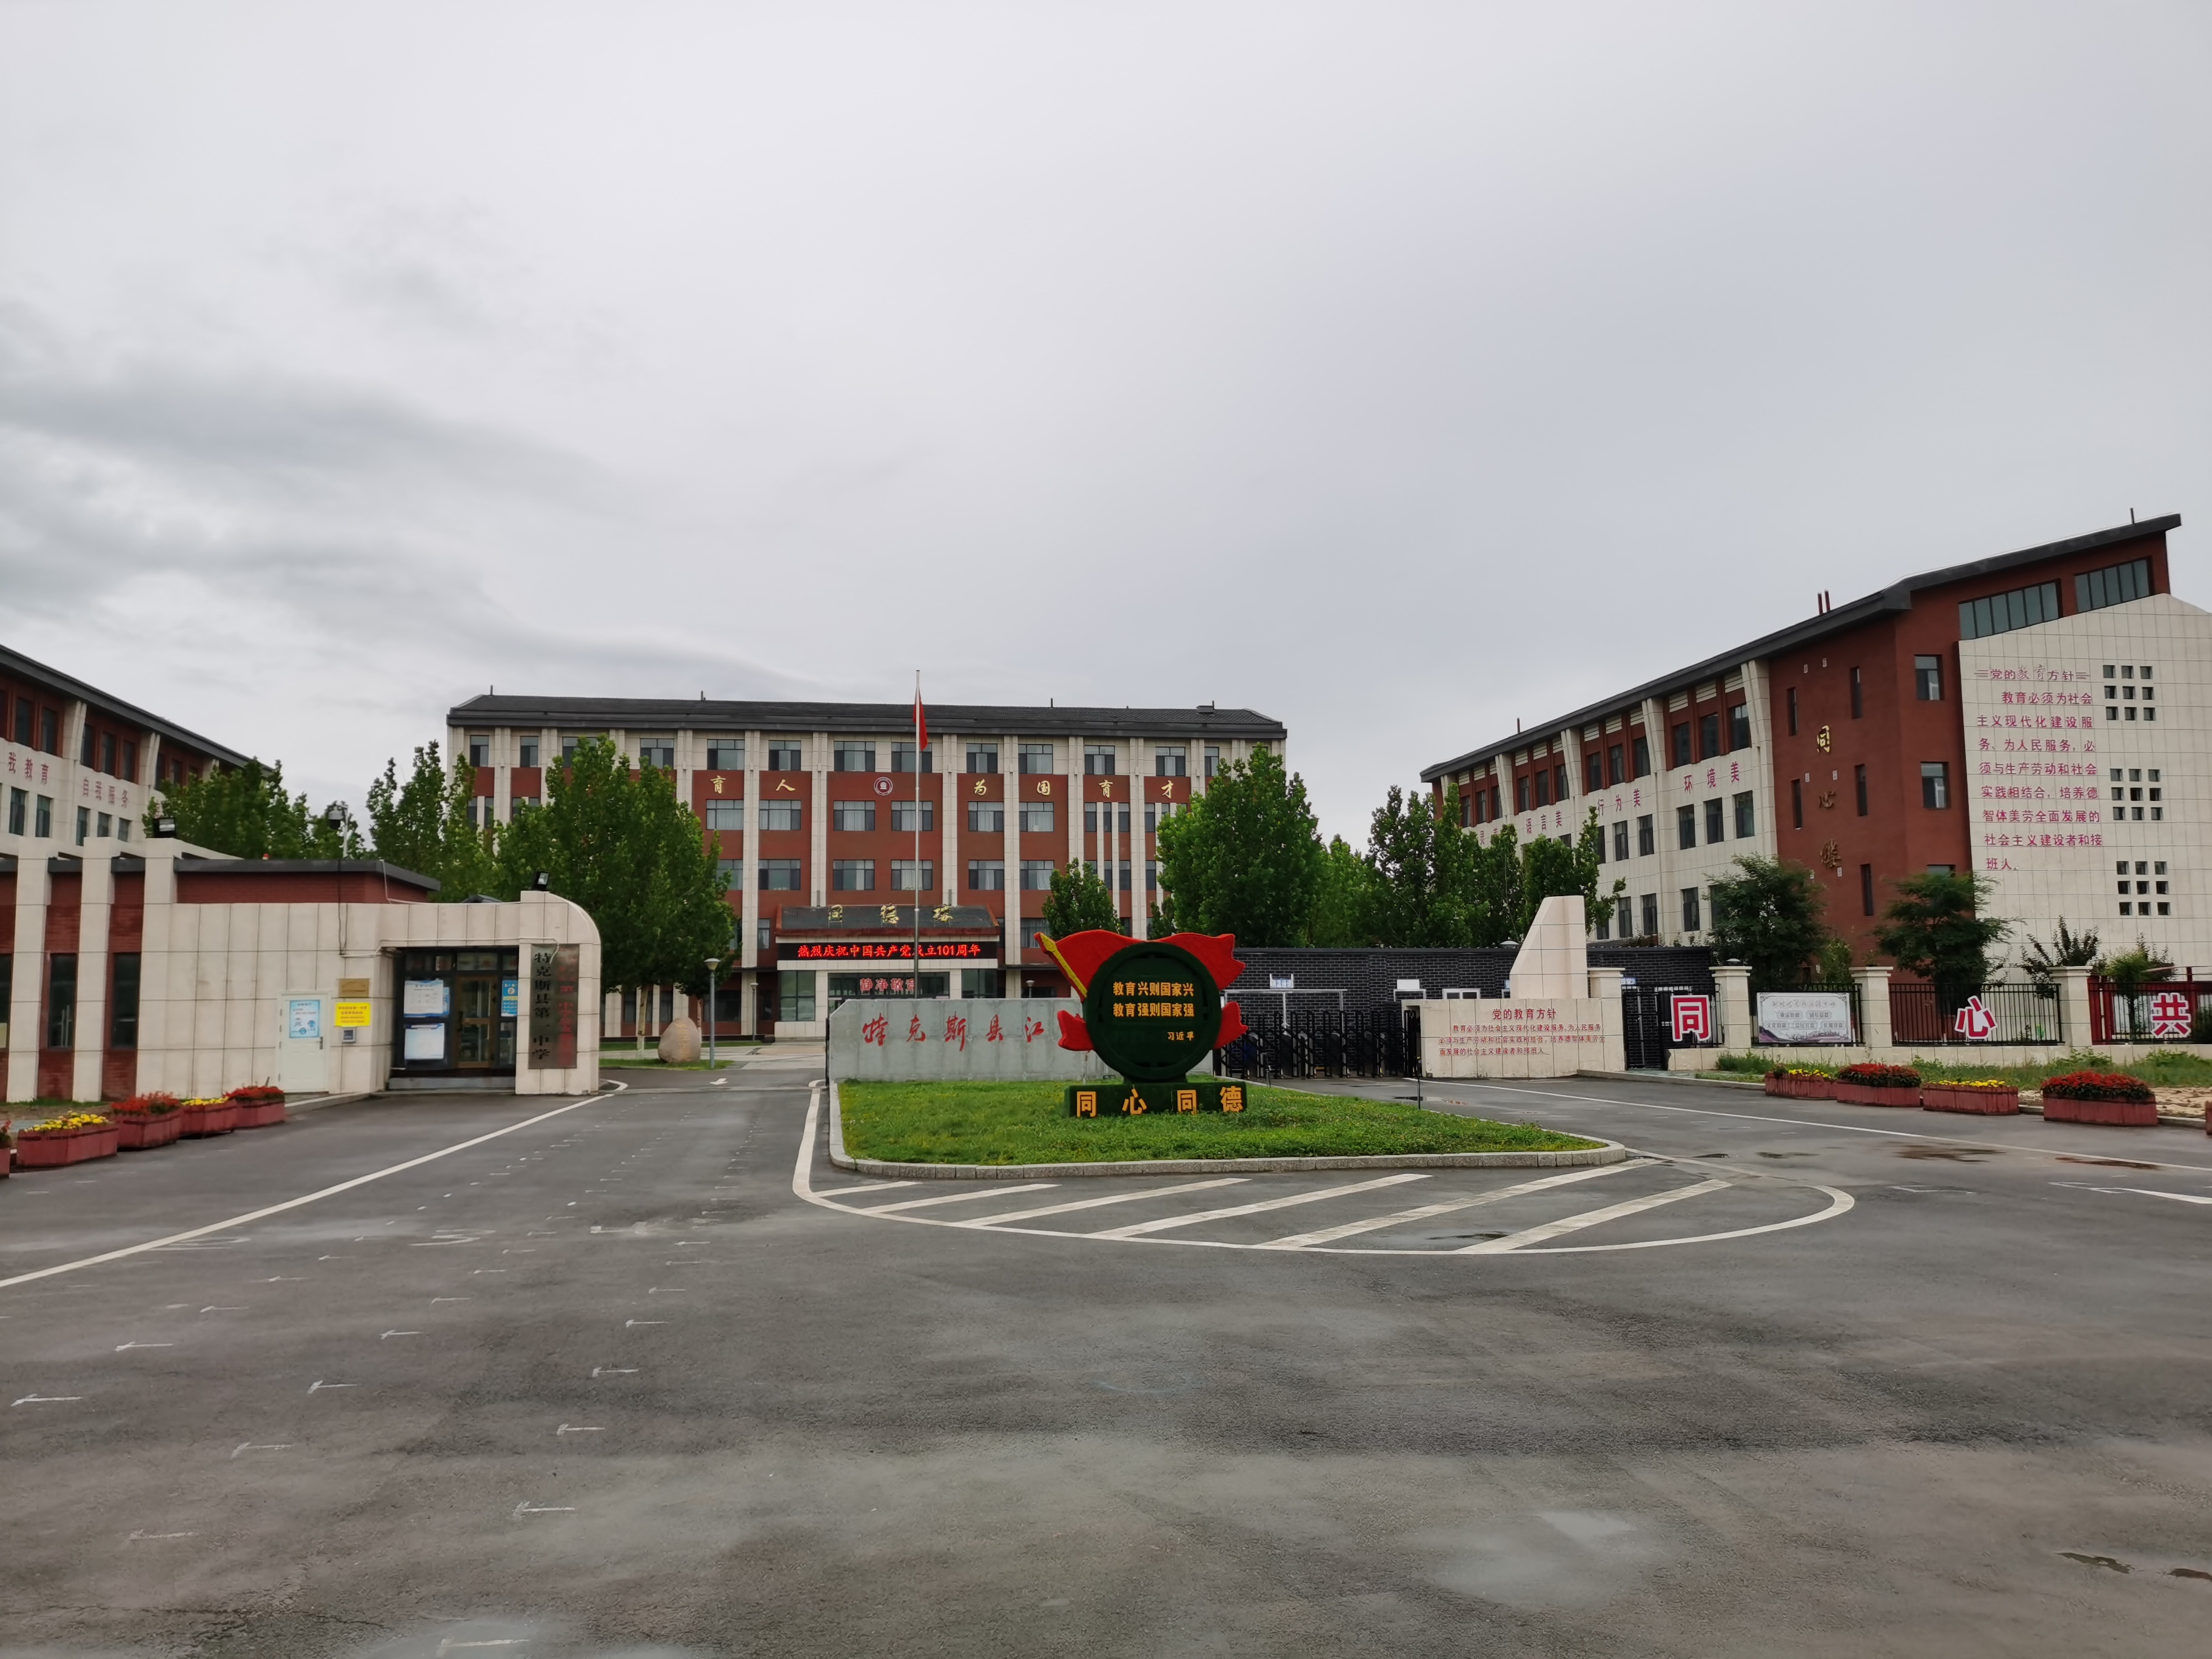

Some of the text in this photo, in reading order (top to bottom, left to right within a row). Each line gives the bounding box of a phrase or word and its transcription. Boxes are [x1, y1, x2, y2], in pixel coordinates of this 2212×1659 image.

[2002, 691, 2093, 705] 教育必须为社会
[1977, 715, 2093, 728] 主义现代化建设服
[1979, 762, 2097, 775] 须与生产劳动和社会
[1683, 761, 1740, 794] 环境美
[1597, 788, 1641, 817] 行为美
[1526, 810, 1562, 834] 语言美
[1983, 809, 2100, 823] 智体美劳全面发展的
[1984, 833, 2103, 846] 社会主义建设者和接
[1113, 982, 1194, 996] 教育兴则国家兴
[1113, 1002, 1195, 1017] 教育强则国家强
[1492, 1008, 1557, 1019] 党的教育方针
[1671, 993, 2191, 1041] 同 心 共
[1167, 1031, 1194, 1041] 习近平
[1076, 1086, 1244, 1117] 同心同德
